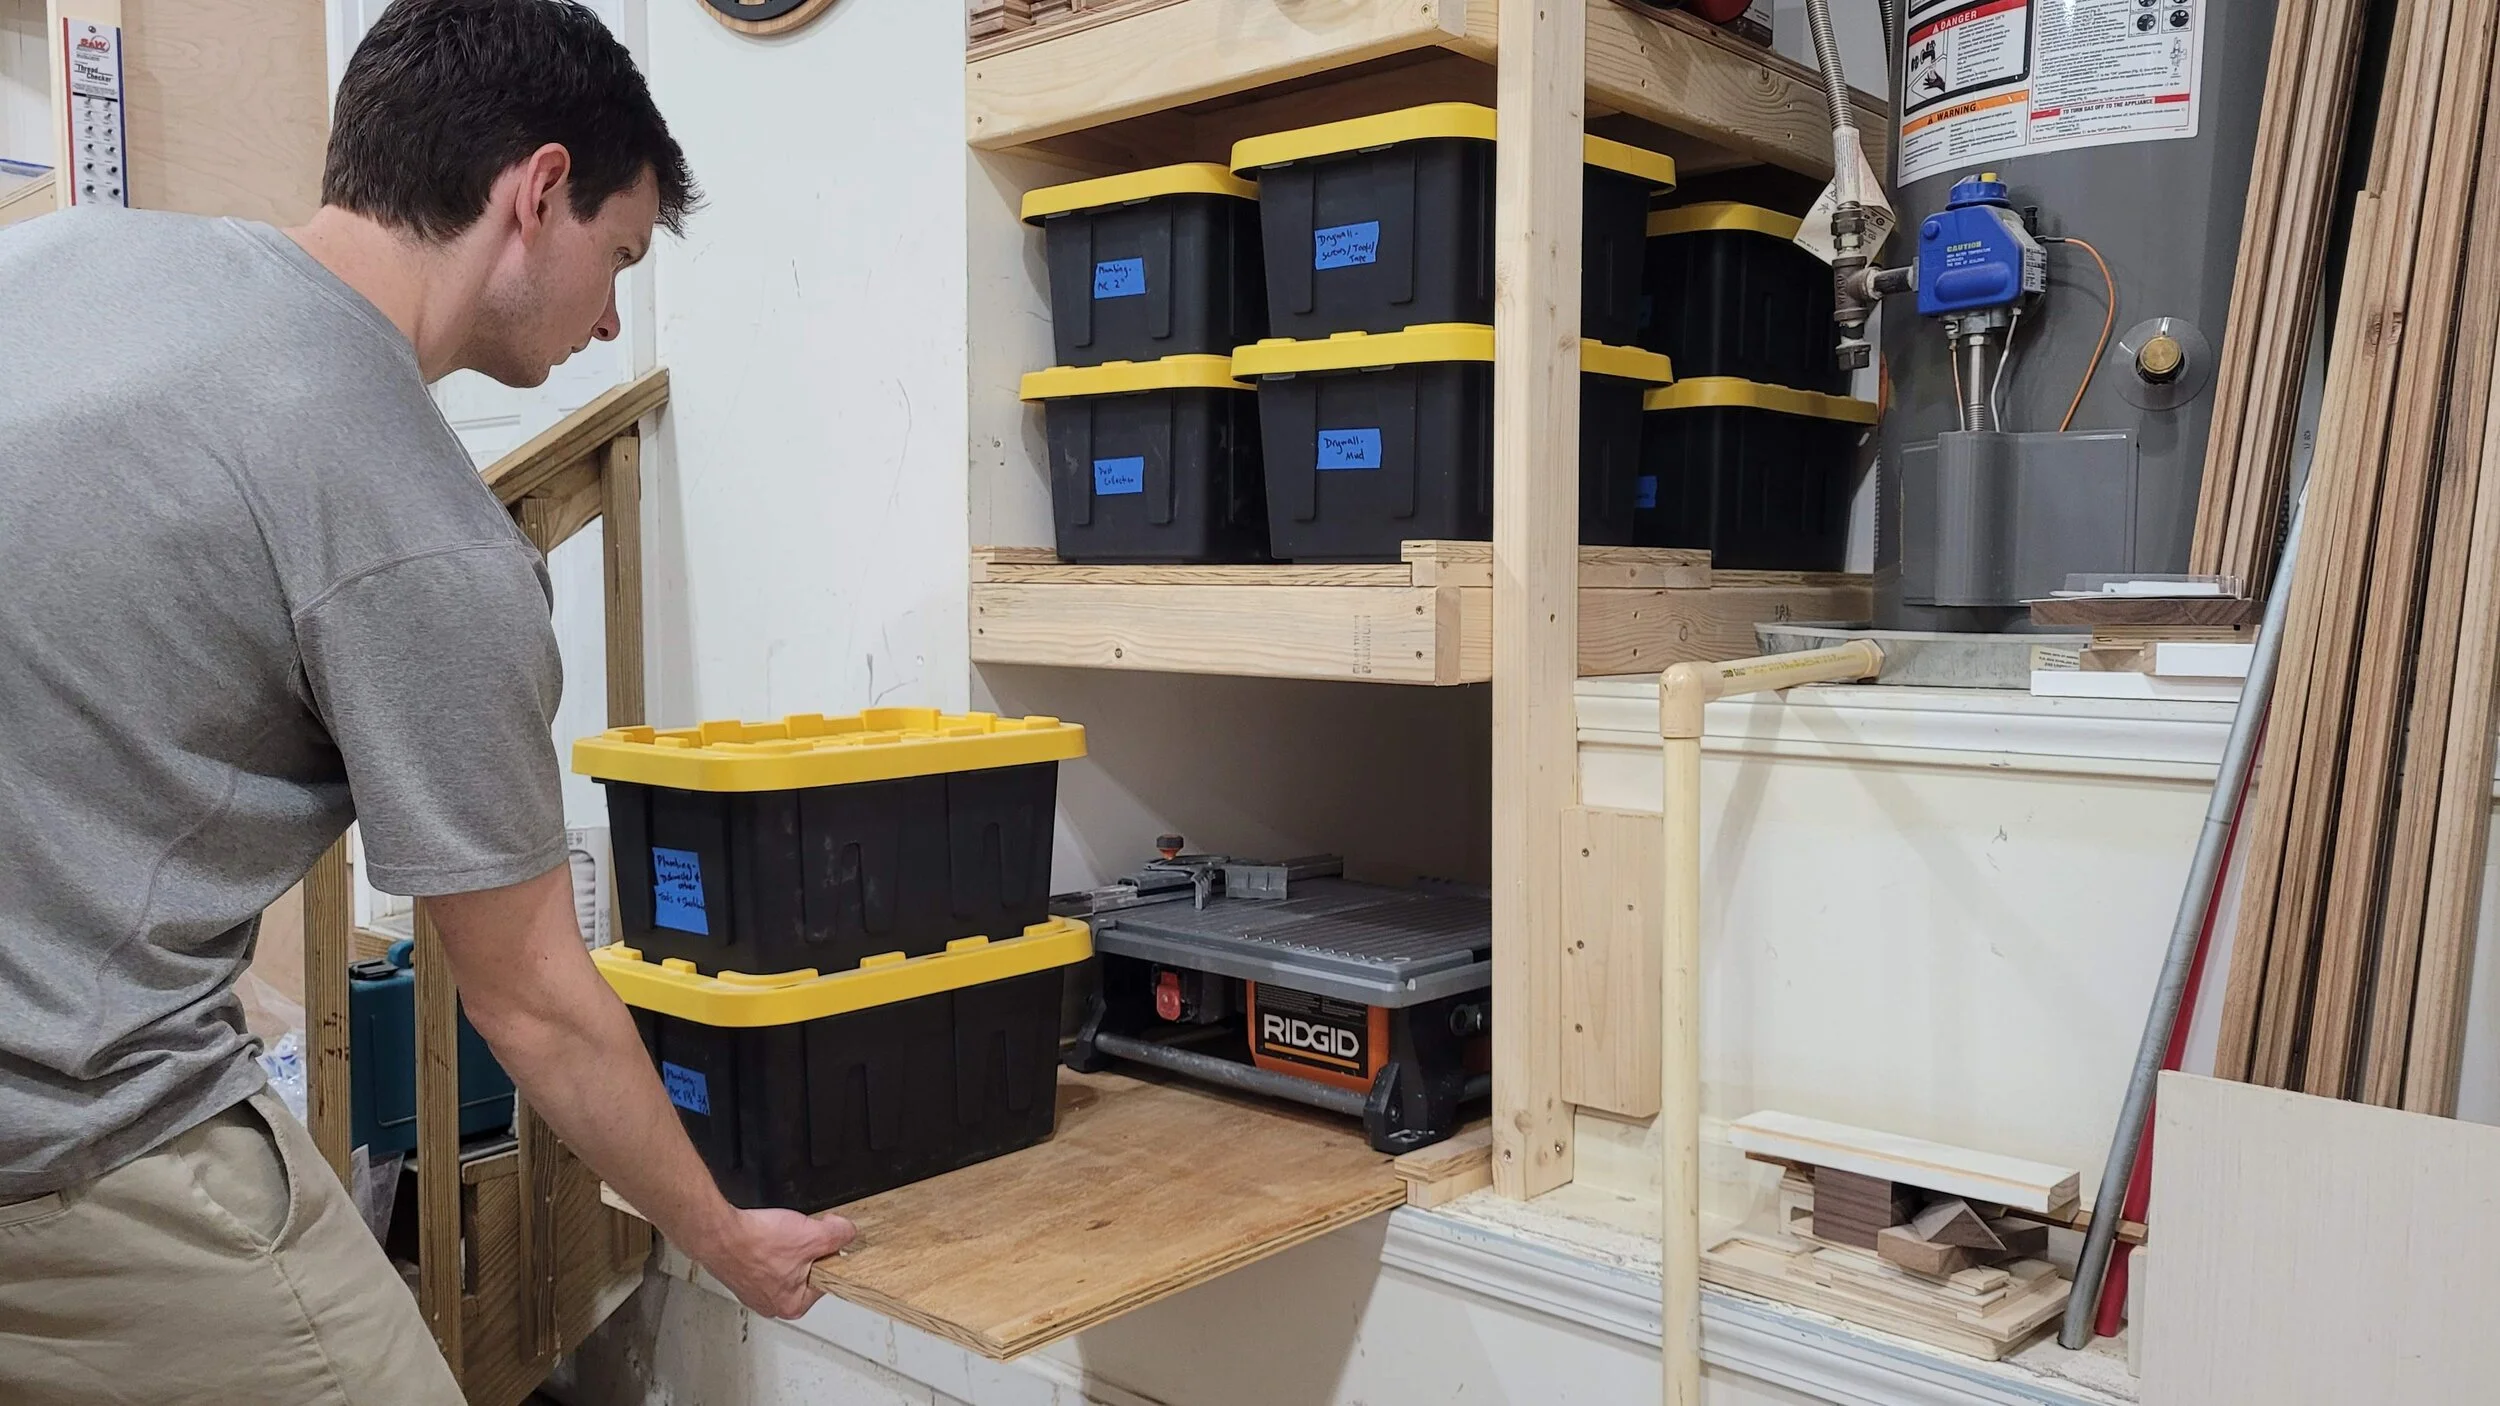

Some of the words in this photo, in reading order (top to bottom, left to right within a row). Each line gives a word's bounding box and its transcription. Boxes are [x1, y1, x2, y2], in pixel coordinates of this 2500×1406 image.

[1940, 10, 1977, 30] DANGER
[75, 63, 98, 74] Thread
[87, 72, 112, 82] Checker
[2124, 99, 2153, 108] APPLIANCE
[1937, 103, 1977, 121] WARNING
[1946, 241, 1982, 253] CAUTION
[1345, 448, 1364, 461] Mud
[1263, 1013, 1360, 1058] RIDGID
